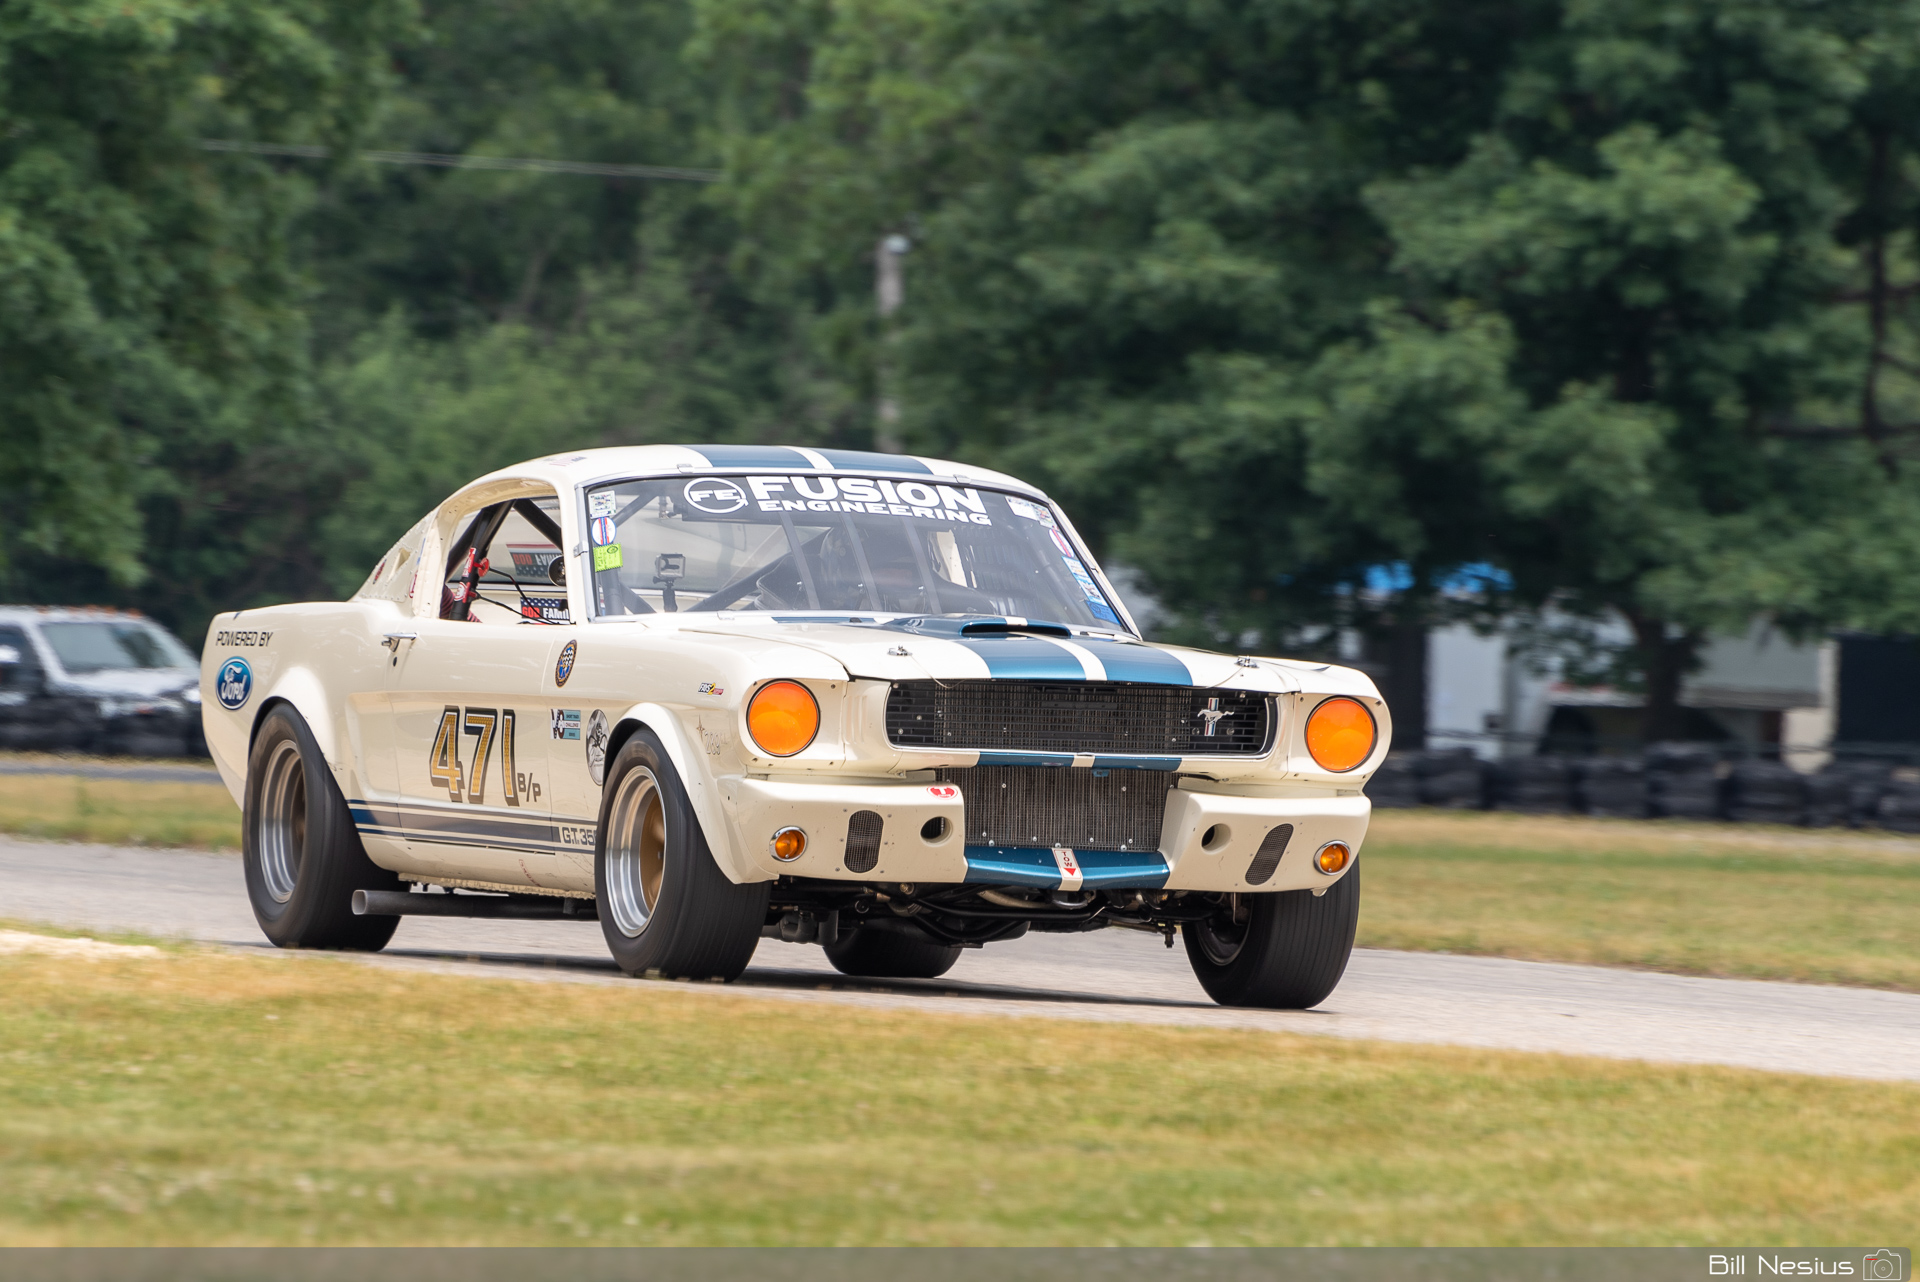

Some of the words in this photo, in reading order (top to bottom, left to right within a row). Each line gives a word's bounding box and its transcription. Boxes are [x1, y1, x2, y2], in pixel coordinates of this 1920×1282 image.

[689, 489, 740, 502] FE
[746, 476, 987, 513] FUSION
[757, 500, 992, 526] ENGINEERING
[522, 606, 540, 618] GOD
[215, 631, 258, 646] POWERED
[258, 631, 273, 647] BY
[221, 664, 247, 700] Ford
[429, 705, 519, 806] 471
[517, 772, 541, 802] B/P
[1062, 851, 1073, 867] TOW
